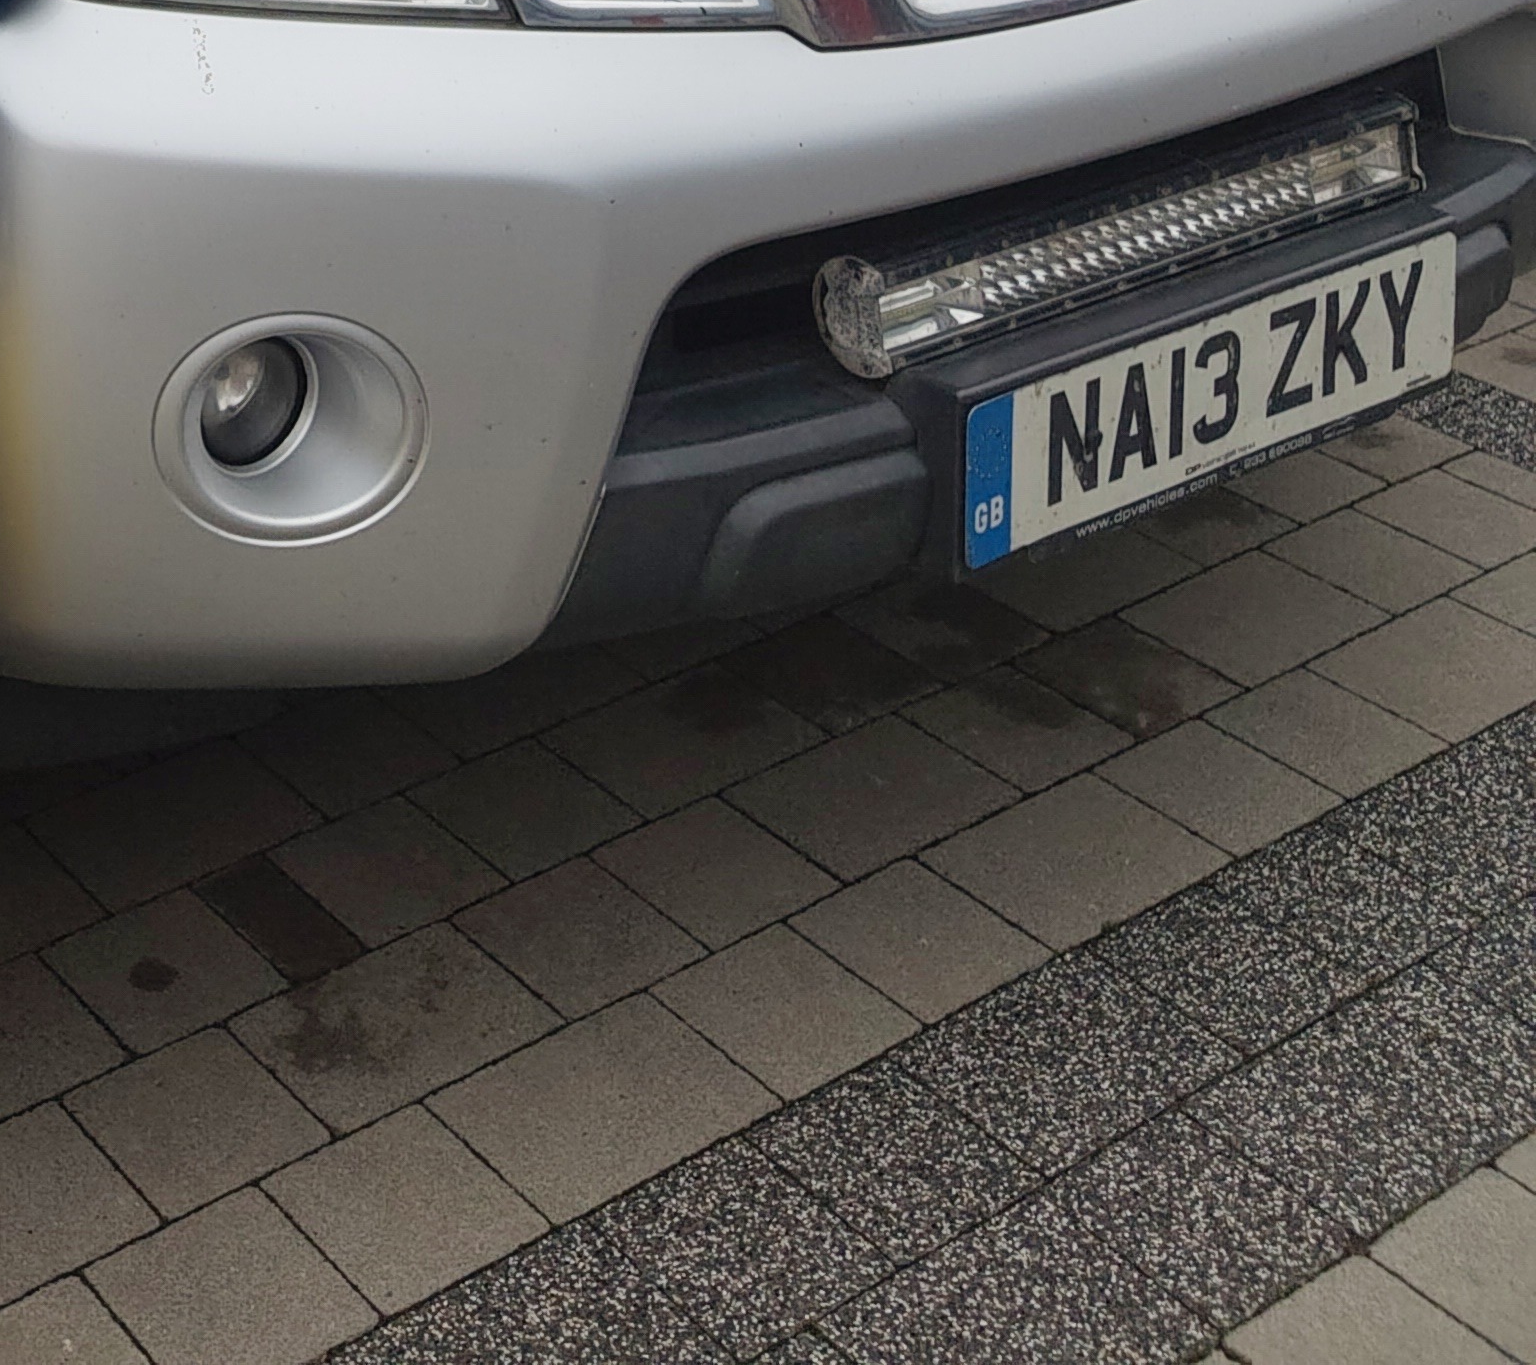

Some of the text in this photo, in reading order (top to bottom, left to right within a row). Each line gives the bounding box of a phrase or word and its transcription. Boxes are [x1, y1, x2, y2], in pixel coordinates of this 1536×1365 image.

[1047, 259, 1424, 507] NA13 ZKY
[974, 495, 1004, 535] GB
[1075, 473, 1219, 539] www.dpvehicles.com
